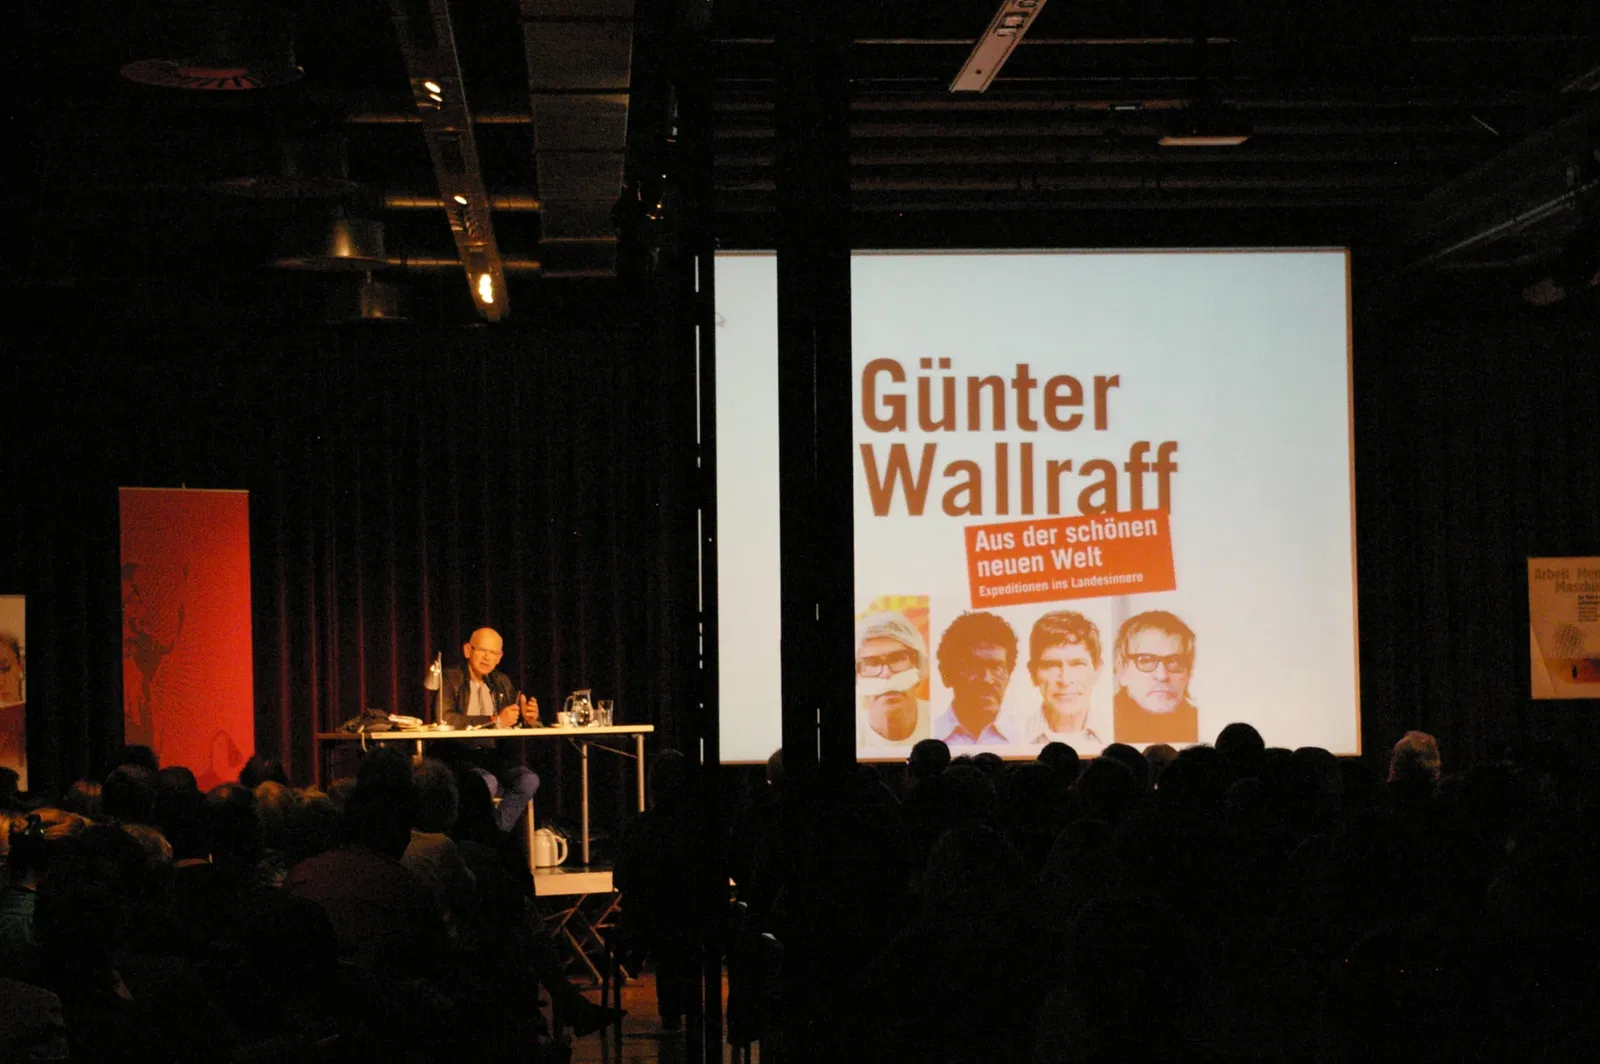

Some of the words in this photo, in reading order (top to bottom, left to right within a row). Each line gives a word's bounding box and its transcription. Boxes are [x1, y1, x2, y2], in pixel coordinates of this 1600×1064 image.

[861, 357, 1120, 433] Günter
[859, 440, 1178, 517] Wallraff
[975, 530, 1015, 552] Aus
[1023, 526, 1057, 547] der
[1065, 518, 1158, 543] schönen
[977, 554, 1044, 577] neuen
[1050, 546, 1103, 571] Welt
[979, 580, 1049, 598] Expeditionen
[1052, 577, 1068, 590] ins
[1071, 572, 1143, 589] Landesinnere
